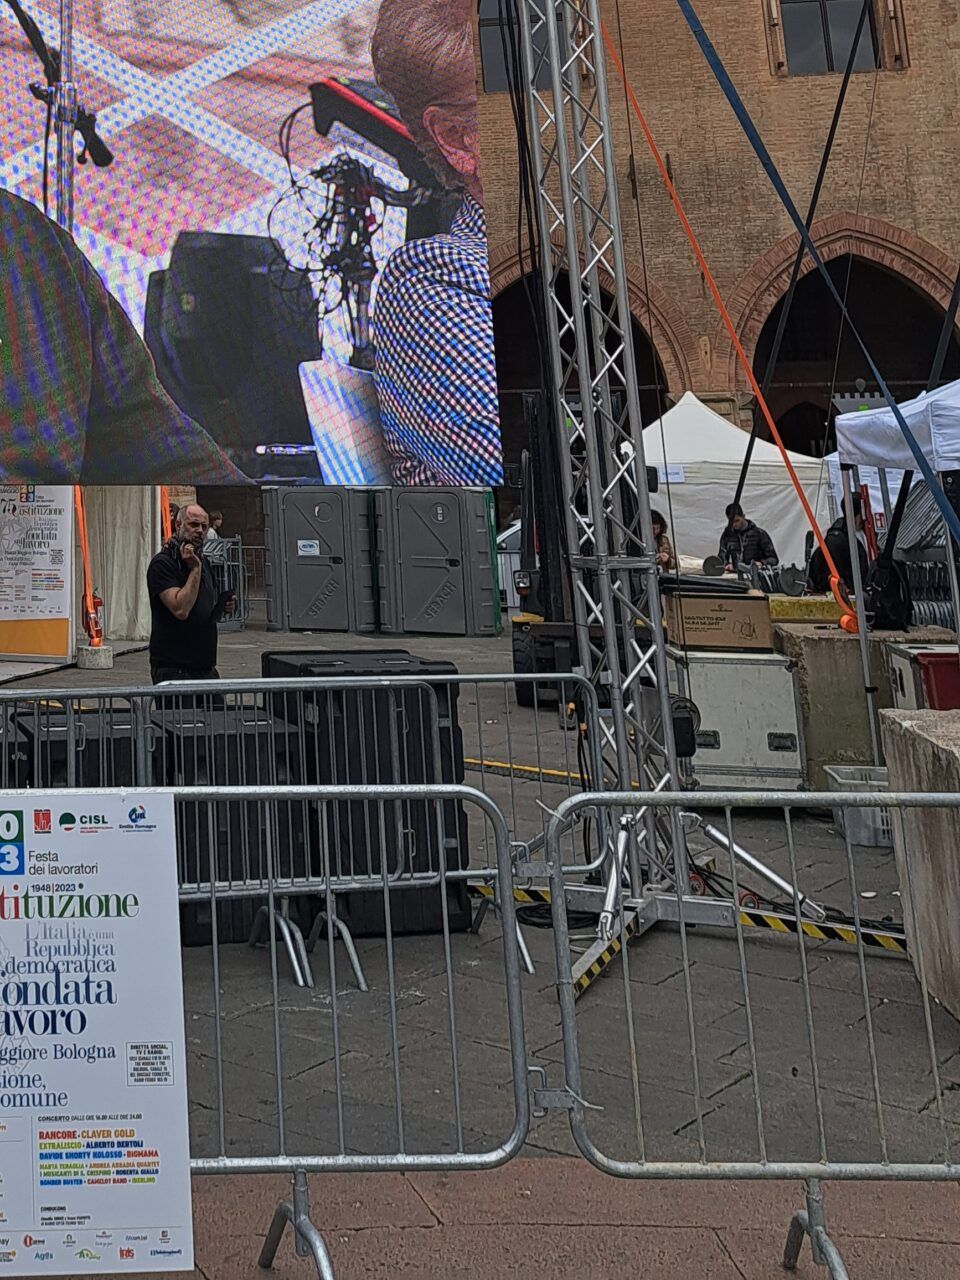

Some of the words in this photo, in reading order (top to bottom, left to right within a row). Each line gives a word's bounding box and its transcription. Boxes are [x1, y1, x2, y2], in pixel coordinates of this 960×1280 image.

[80, 815, 108, 824] CISL
[29, 851, 58, 862] Festa
[29, 864, 45, 875] dei
[48, 862, 98, 875] lavoratori
[24, 922, 88, 940] L'Italia
[96, 931, 114, 939] una
[24, 939, 116, 961] Repubblica
[5, 956, 116, 974] democratica
[53, 1044, 116, 1064] Bologna
[39, 1130, 77, 1139] RANCORE
[81, 1129, 112, 1138] CLAVER
[114, 1129, 135, 1138] GOLD
